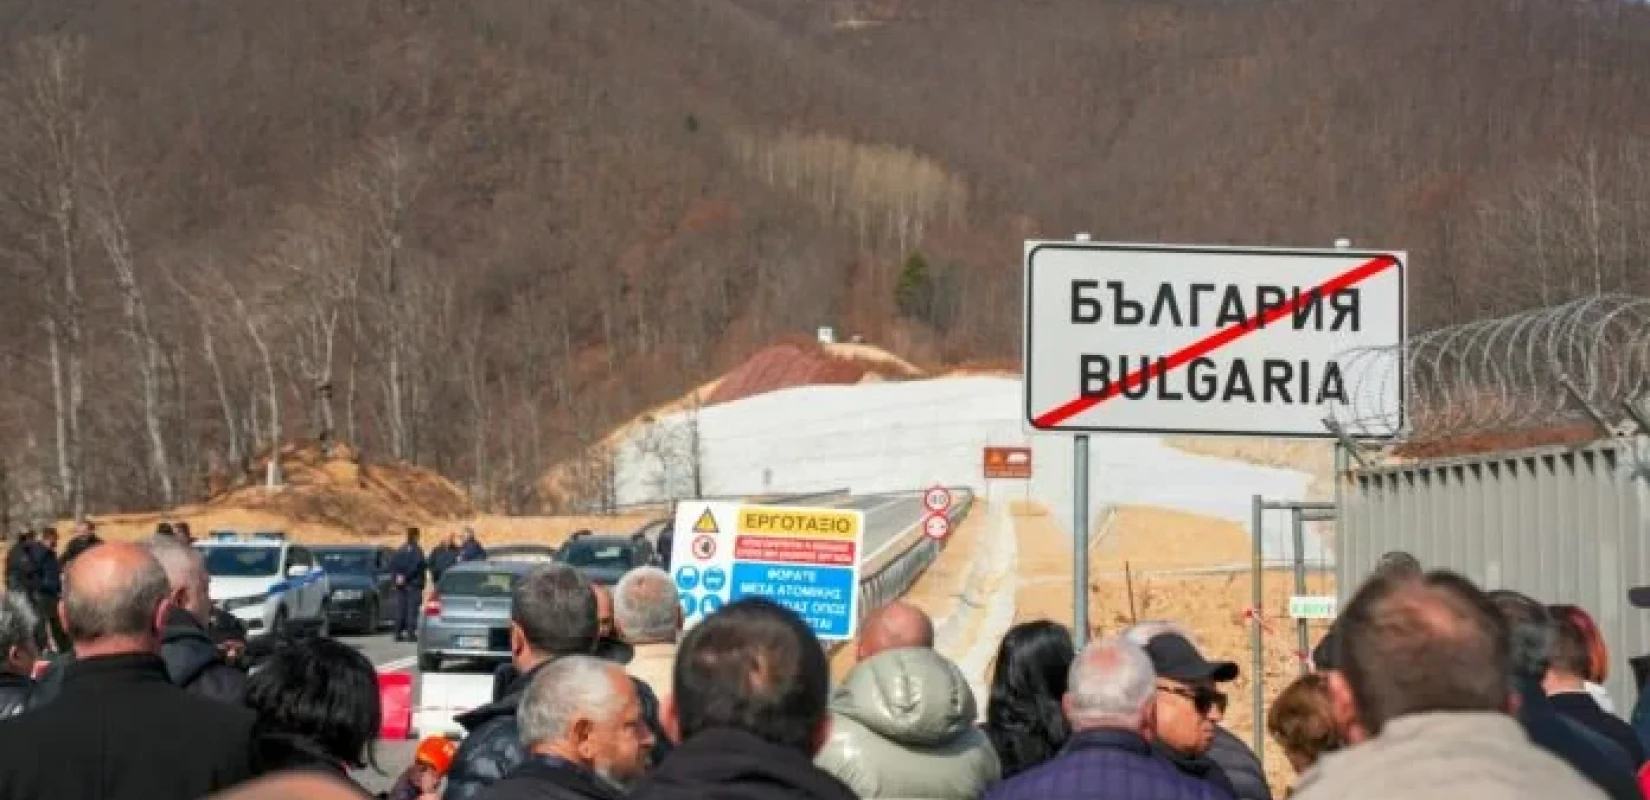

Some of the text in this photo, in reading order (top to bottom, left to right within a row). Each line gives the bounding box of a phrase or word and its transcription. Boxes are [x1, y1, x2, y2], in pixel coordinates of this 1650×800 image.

[1070, 278, 1360, 332] БЪЛГАРИЯ
[1080, 354, 1350, 405] BULGARIA
[745, 513, 852, 533] ΕΡΓΟΤΑΞΙΟ
